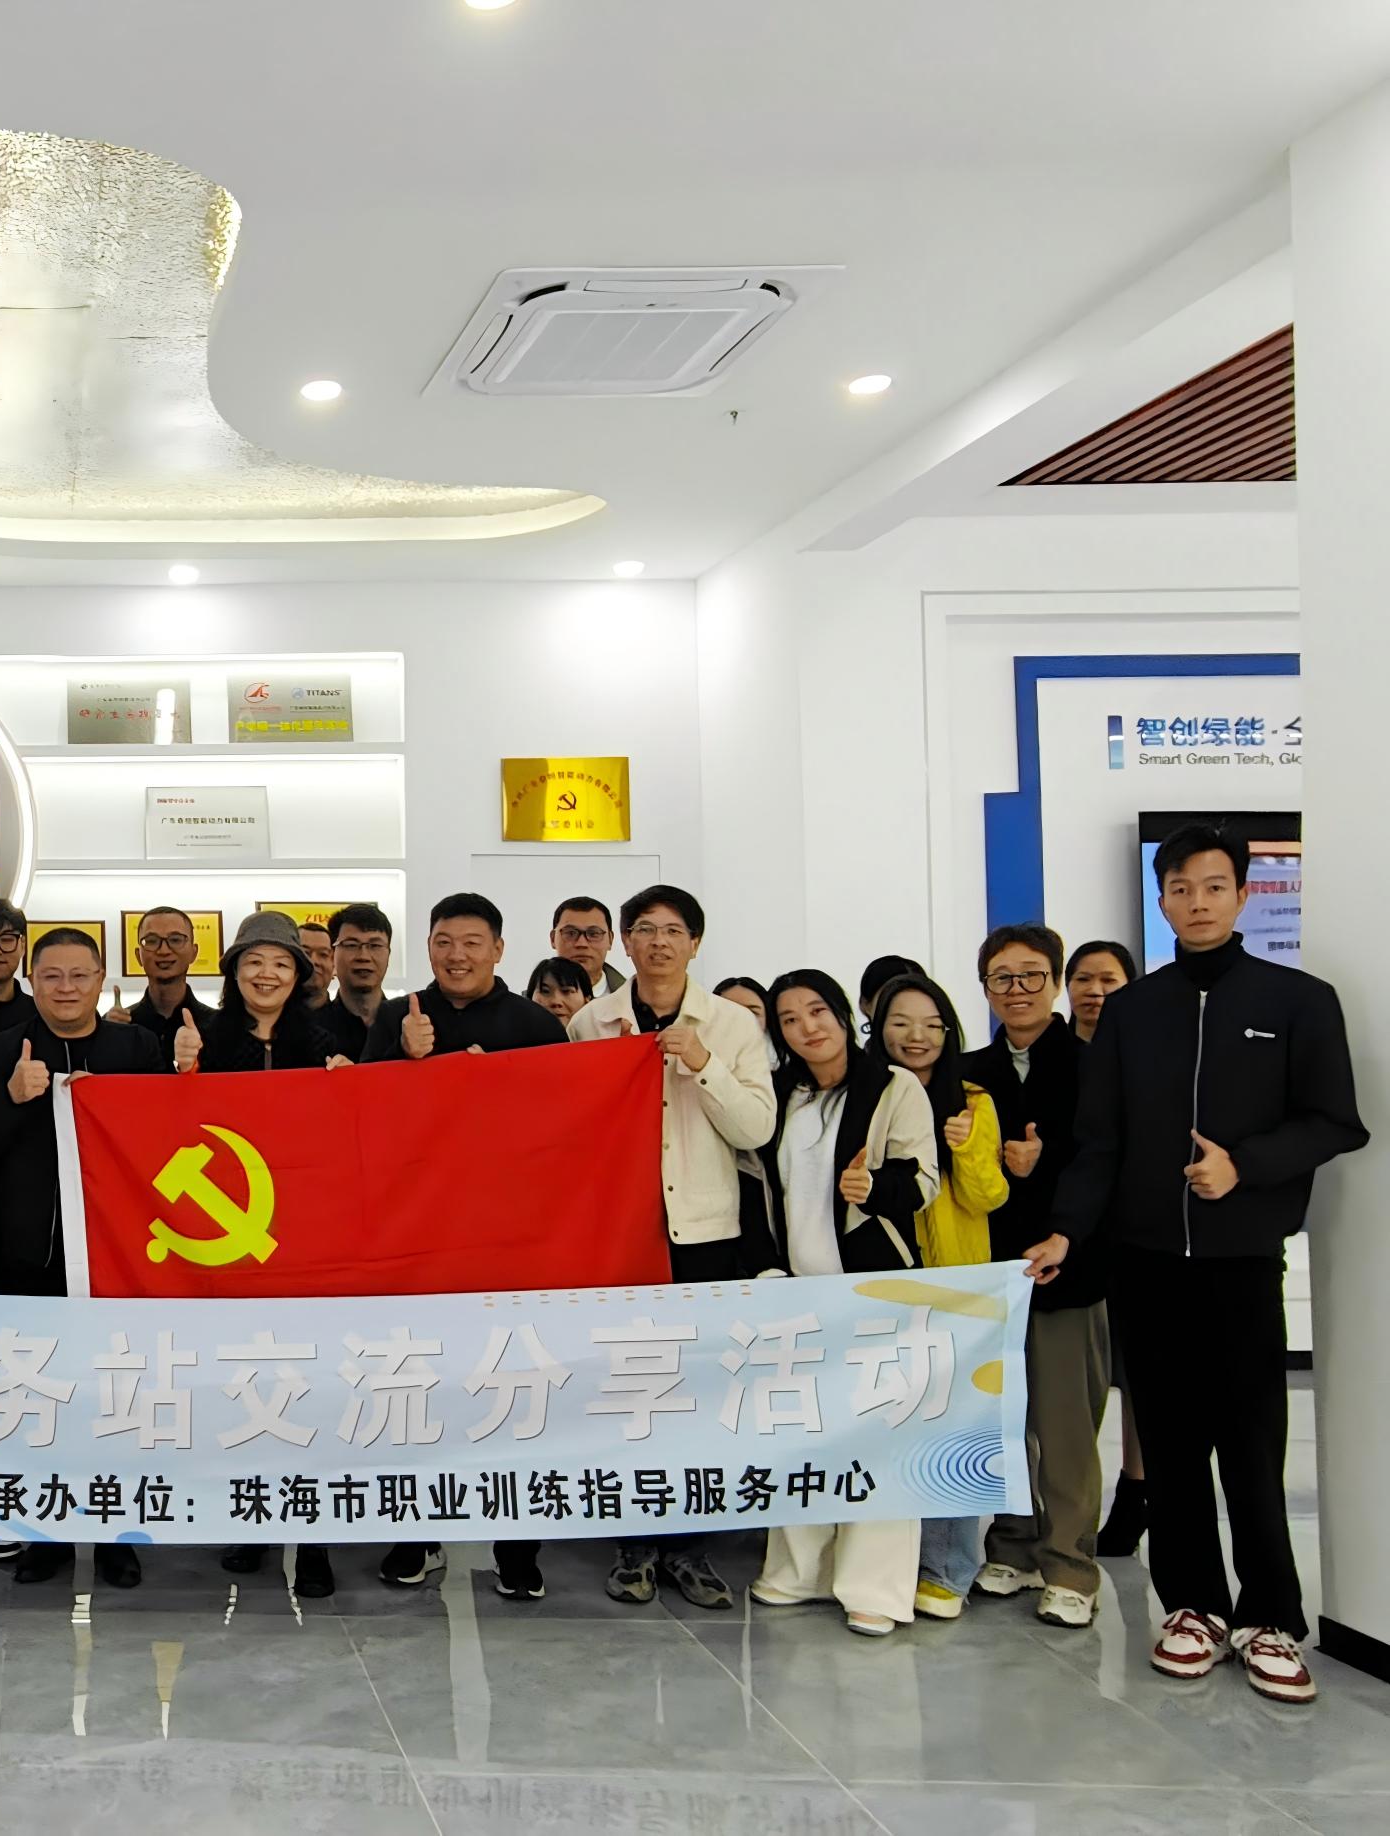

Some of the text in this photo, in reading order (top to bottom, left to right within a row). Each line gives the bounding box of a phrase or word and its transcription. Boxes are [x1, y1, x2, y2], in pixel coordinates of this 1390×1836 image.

[306, 689, 343, 697] TITANS
[1138, 752, 1182, 766] Smart
[1186, 752, 1230, 766] Green
